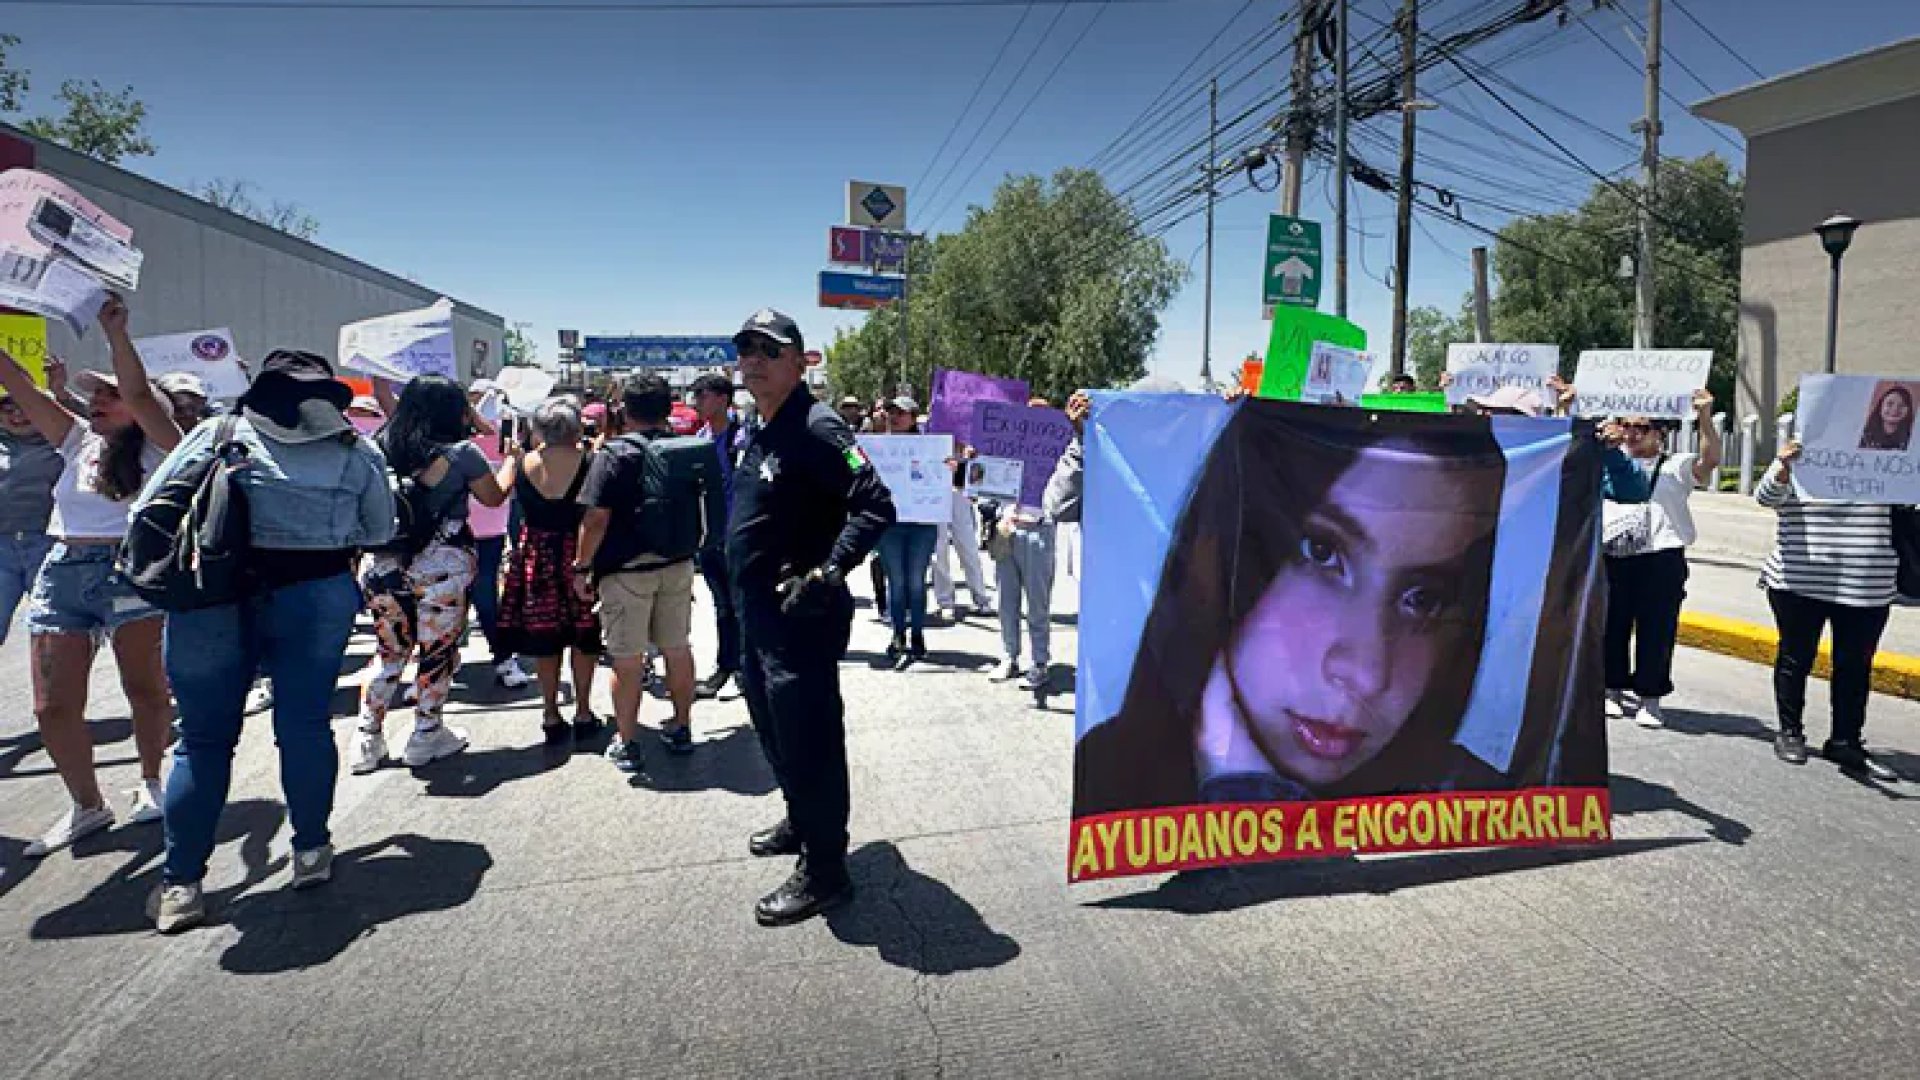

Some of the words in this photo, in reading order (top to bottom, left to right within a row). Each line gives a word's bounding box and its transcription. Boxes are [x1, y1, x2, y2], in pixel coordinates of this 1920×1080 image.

[1073, 808, 1284, 879] AYUDANOS
[1296, 808, 1323, 851] A
[1333, 795, 1607, 848] ENCONTRARLA
